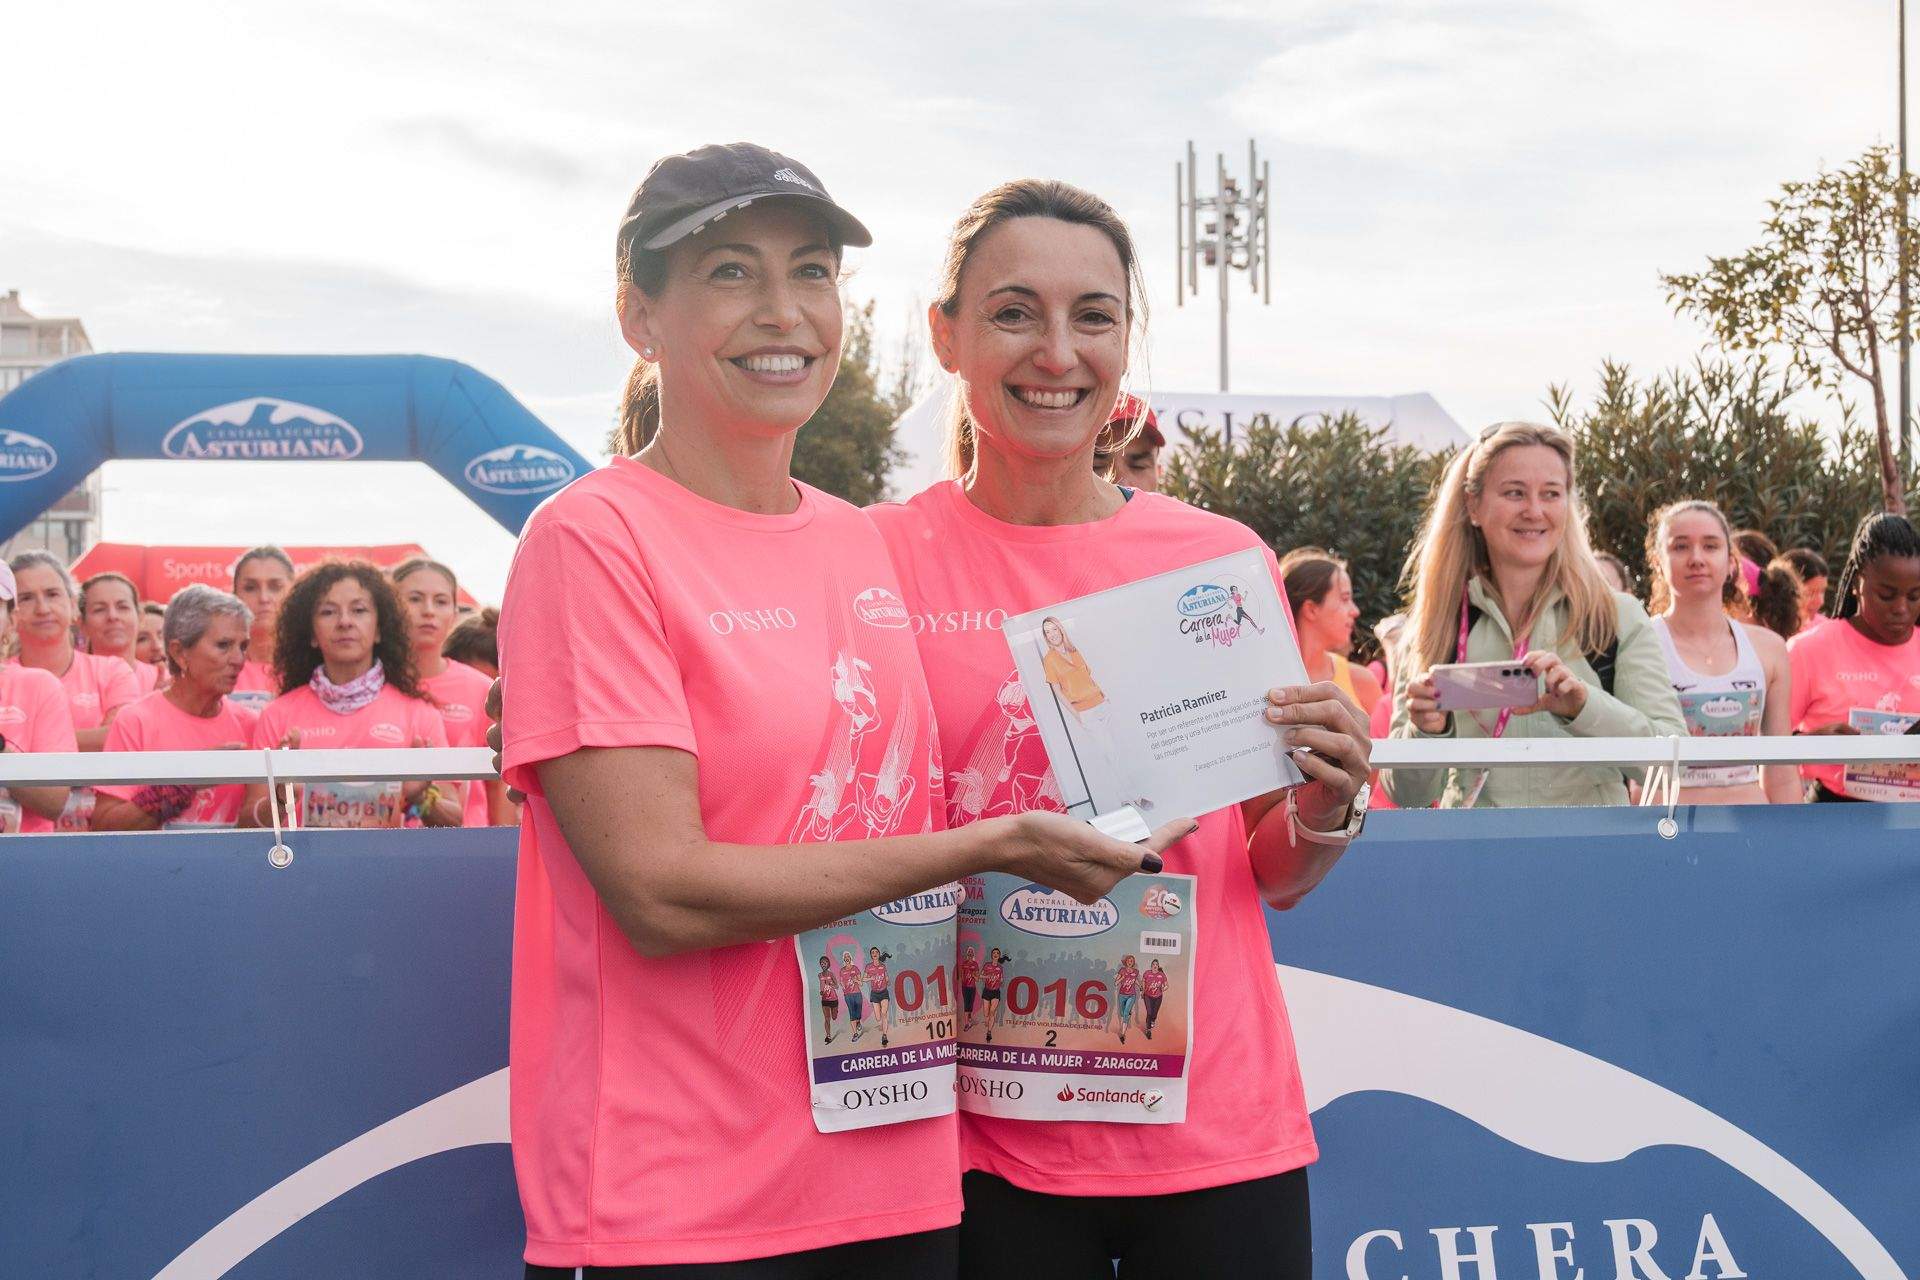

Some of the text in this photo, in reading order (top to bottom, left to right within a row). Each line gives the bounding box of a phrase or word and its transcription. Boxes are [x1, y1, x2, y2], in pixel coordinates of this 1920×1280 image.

[180, 432, 349, 458] ASTURIANA
[475, 463, 567, 484] ASTURIANA
[163, 558, 223, 580] Sports
[1182, 594, 1226, 612] ASTURIANA
[708, 606, 797, 635] OYSHO
[908, 608, 1007, 635] OYSHO
[1180, 613, 1223, 634] Carrera
[1195, 624, 1242, 648] de la Mujer
[1140, 690, 1227, 724] Patricia Ramírez
[1177, 717, 1204, 731] referente
[1161, 735, 1184, 748] deporte
[337, 802, 375, 816] 016
[1007, 898, 1111, 926] ASTURIANA
[1027, 897, 1066, 906] CENTRAL
[894, 965, 957, 1011] 01
[1006, 975, 1108, 1019] 016
[926, 1018, 953, 1040] 101
[1045, 1029, 1057, 1047] 2
[841, 1053, 899, 1073] CARRERA
[901, 1050, 917, 1065] DE
[919, 1048, 934, 1062] LA
[1002, 1051, 1017, 1065] DE
[1021, 1053, 1037, 1066] LA
[1041, 1054, 1083, 1068] MUJER
[1094, 1057, 1159, 1071] ZARAGOZA
[843, 1080, 928, 1110] OYSHO
[960, 1075, 1024, 1100] OYSHO
[1076, 1087, 1145, 1104] Santande
[1345, 1213, 1747, 1280] CHERA
